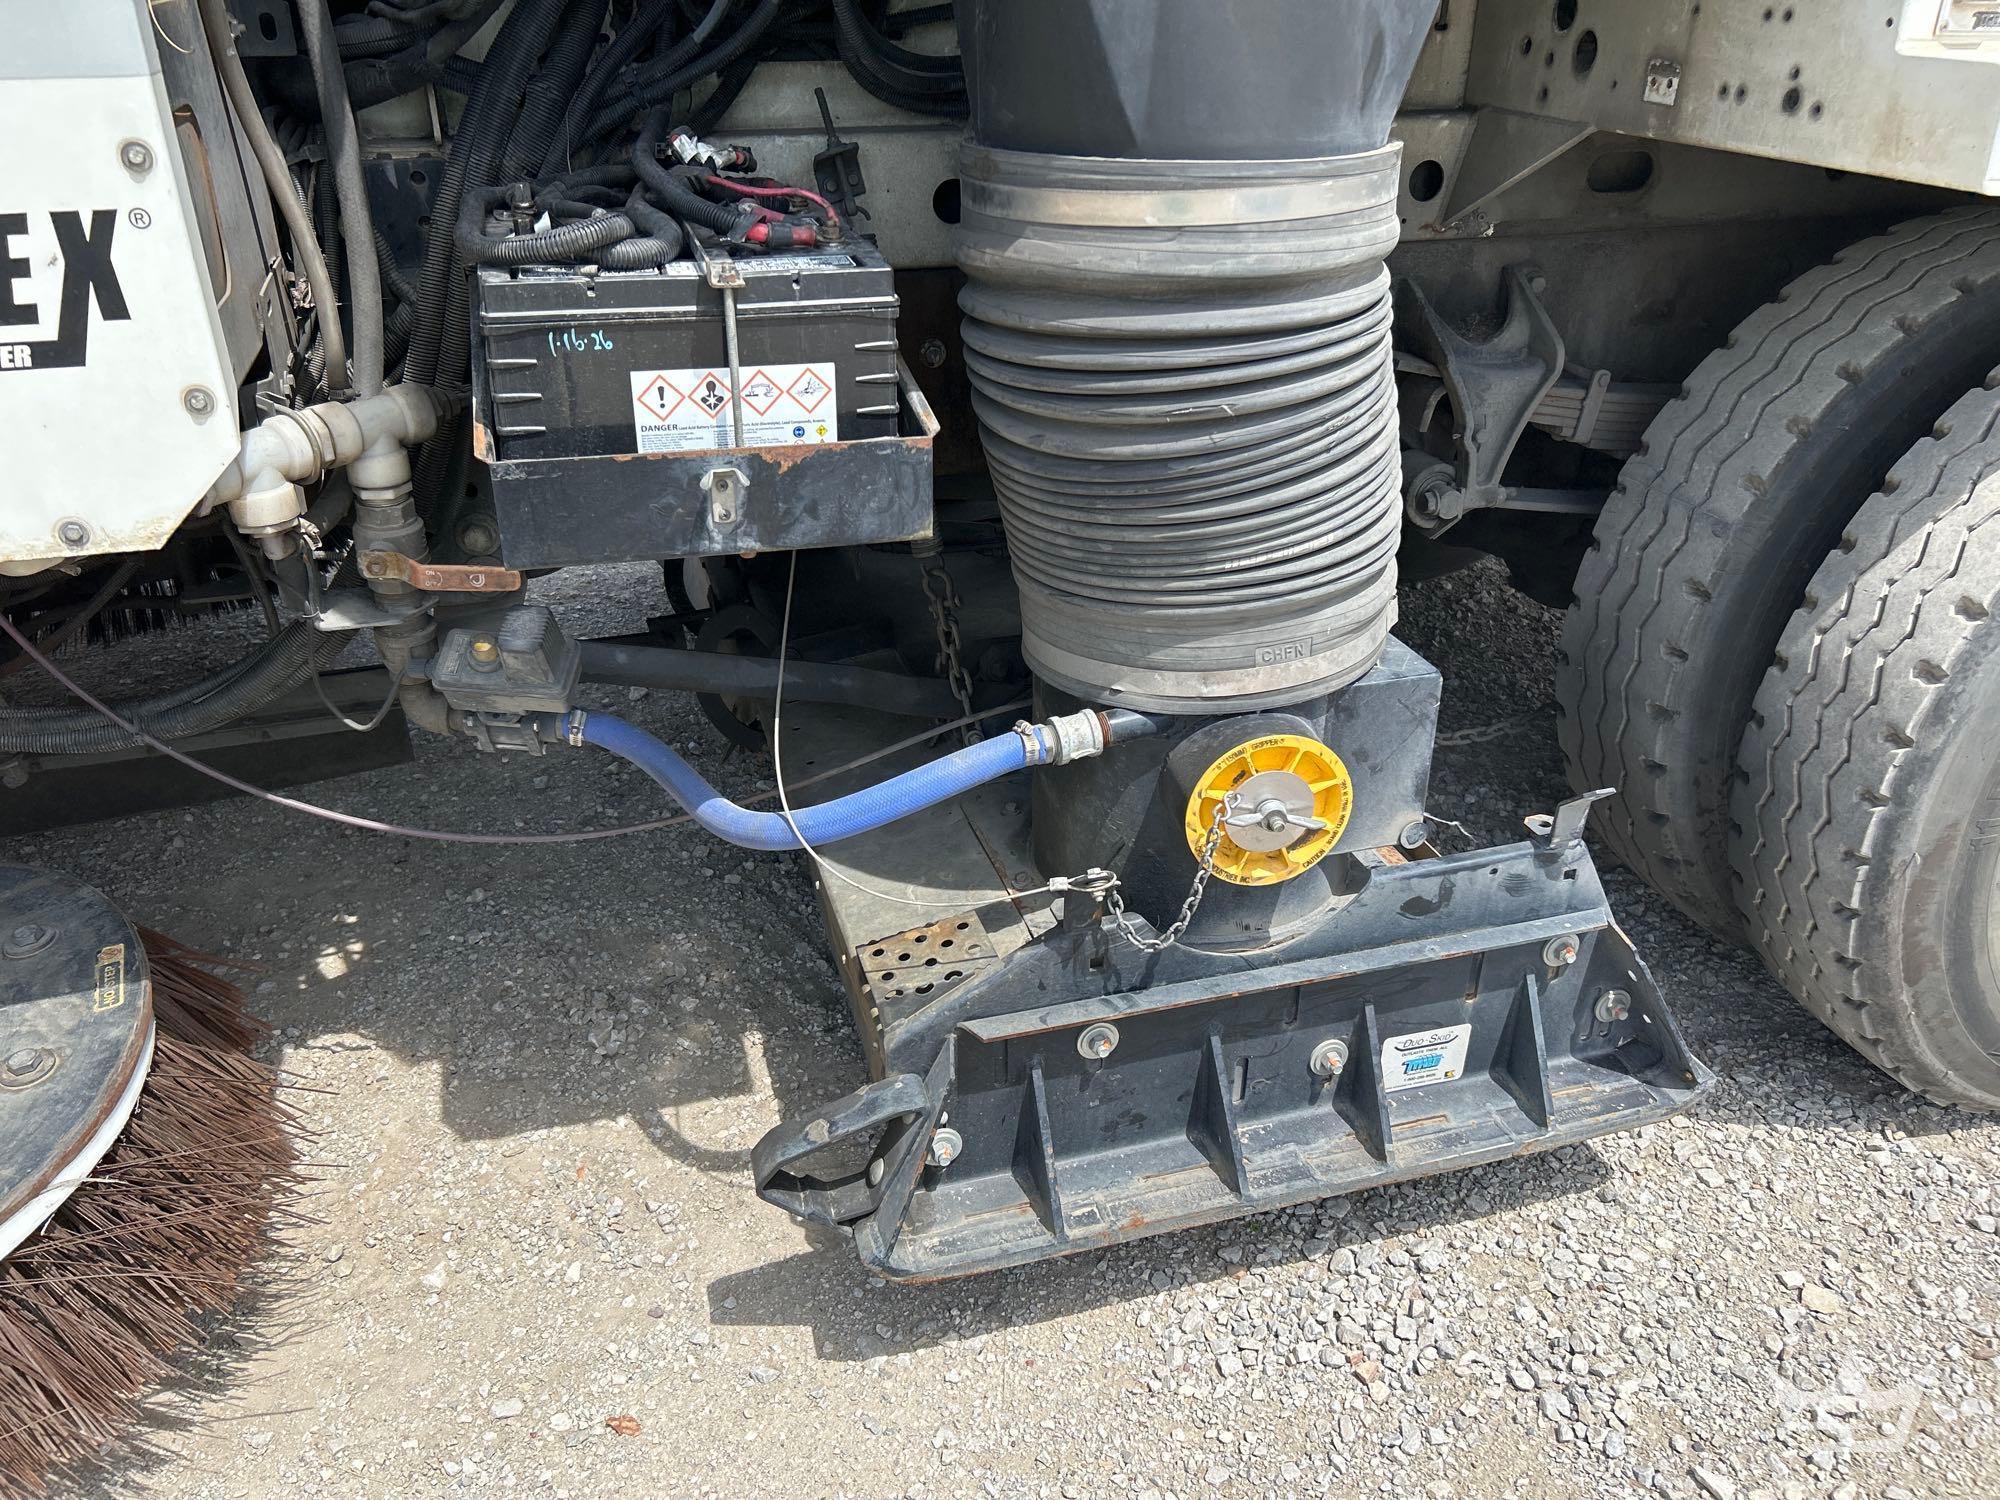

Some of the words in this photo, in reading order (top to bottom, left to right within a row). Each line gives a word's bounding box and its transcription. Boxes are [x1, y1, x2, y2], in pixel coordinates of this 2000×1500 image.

[640, 424, 679, 433] DANGER
[1251, 738, 1279, 751] GRIPPER
[1302, 848, 1326, 868] CAUTION
[103, 965, 116, 987] STEP
[103, 990, 116, 1005] NO
